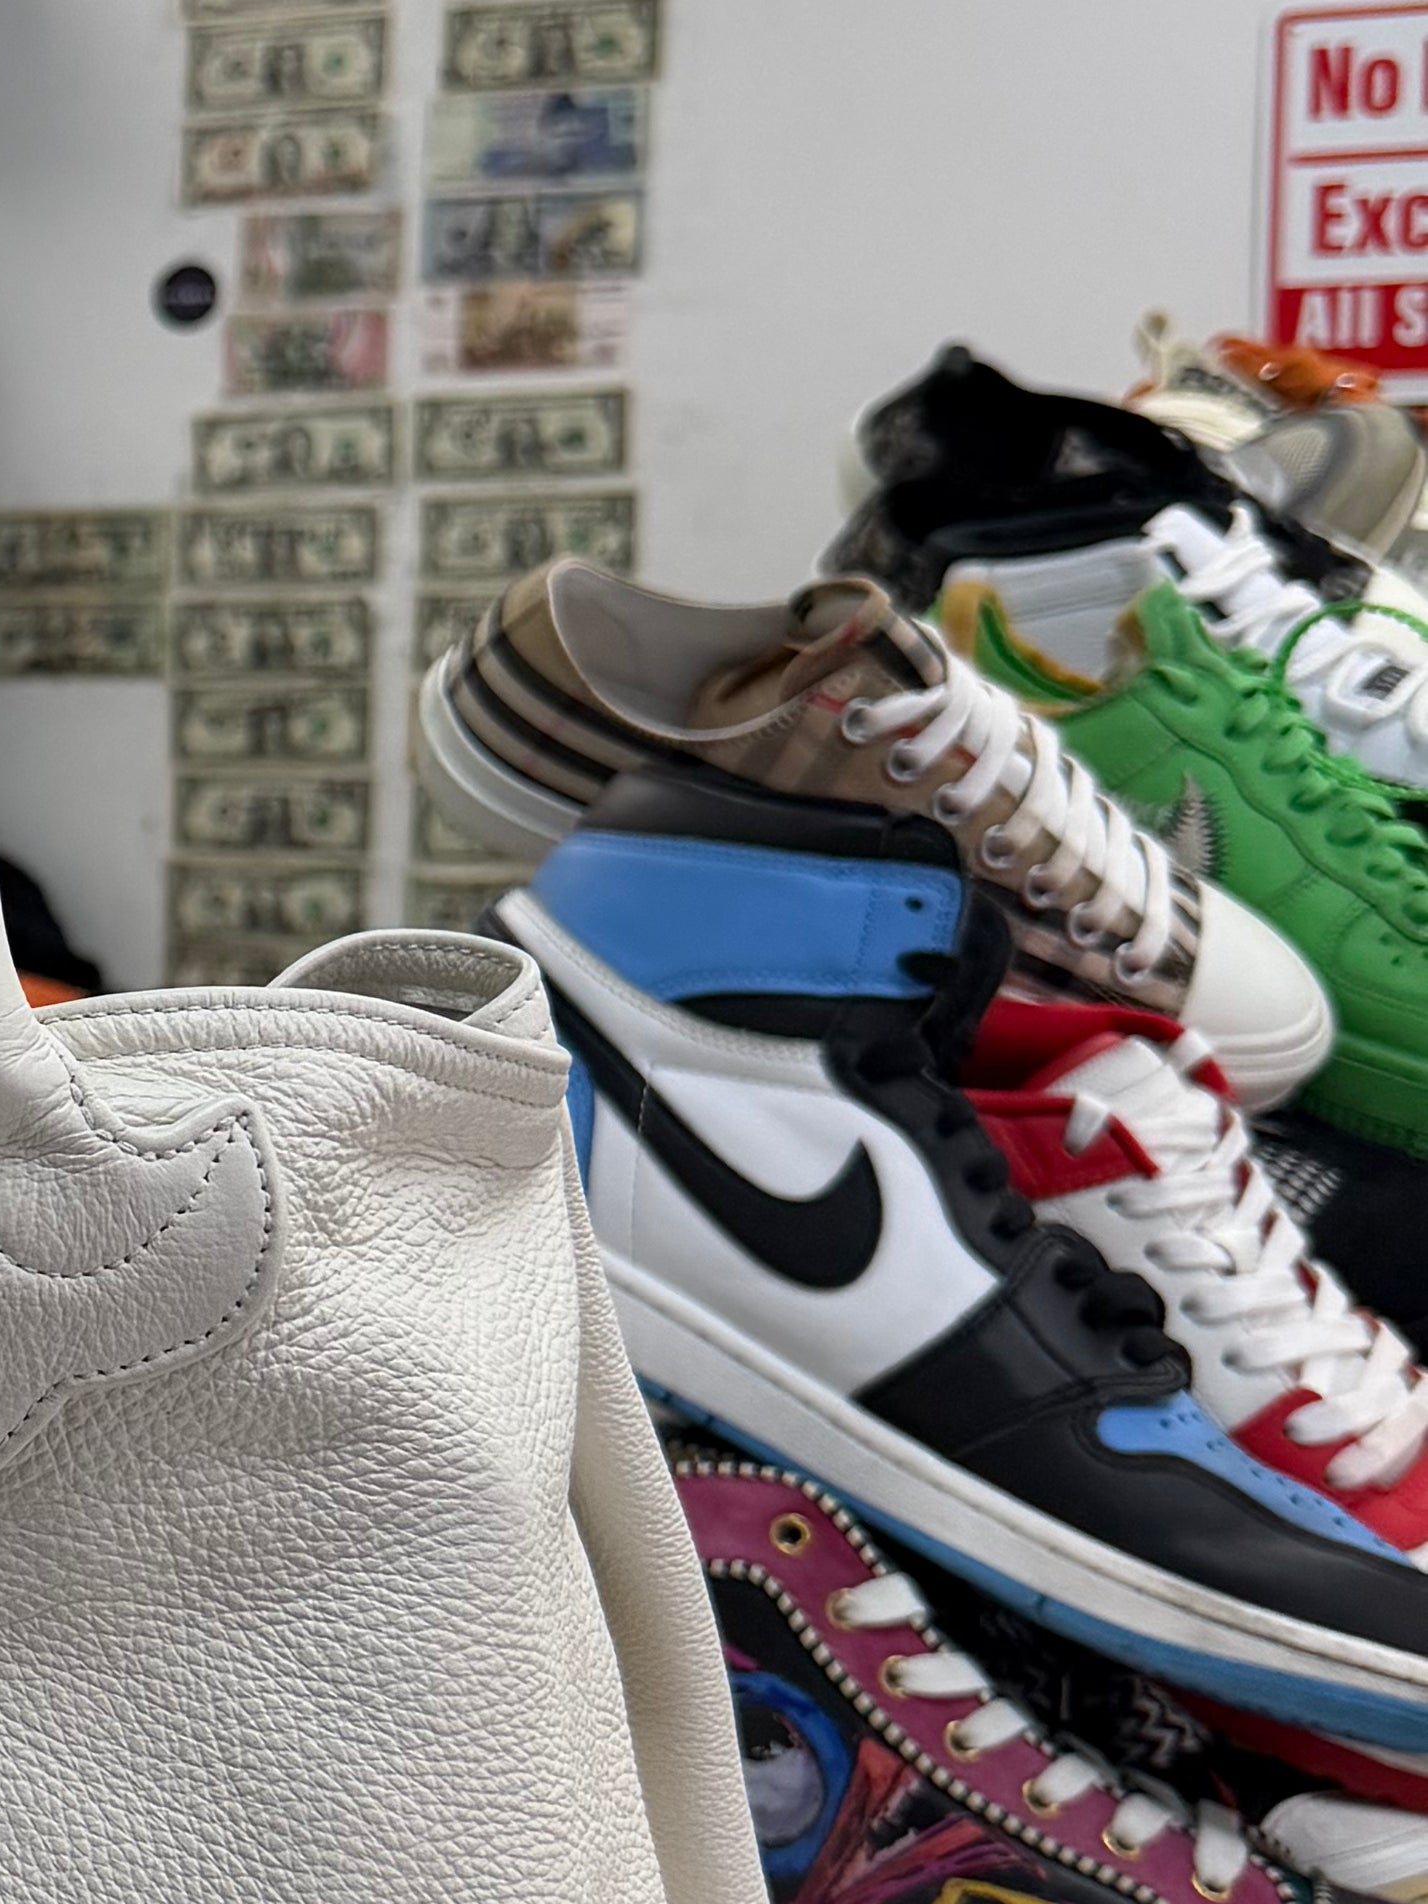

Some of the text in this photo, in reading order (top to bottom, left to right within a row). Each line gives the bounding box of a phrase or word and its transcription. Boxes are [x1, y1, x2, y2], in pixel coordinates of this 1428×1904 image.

[1309, 46, 1401, 119] No
[1312, 182, 1428, 257] Exc
[1296, 288, 1384, 350] All
